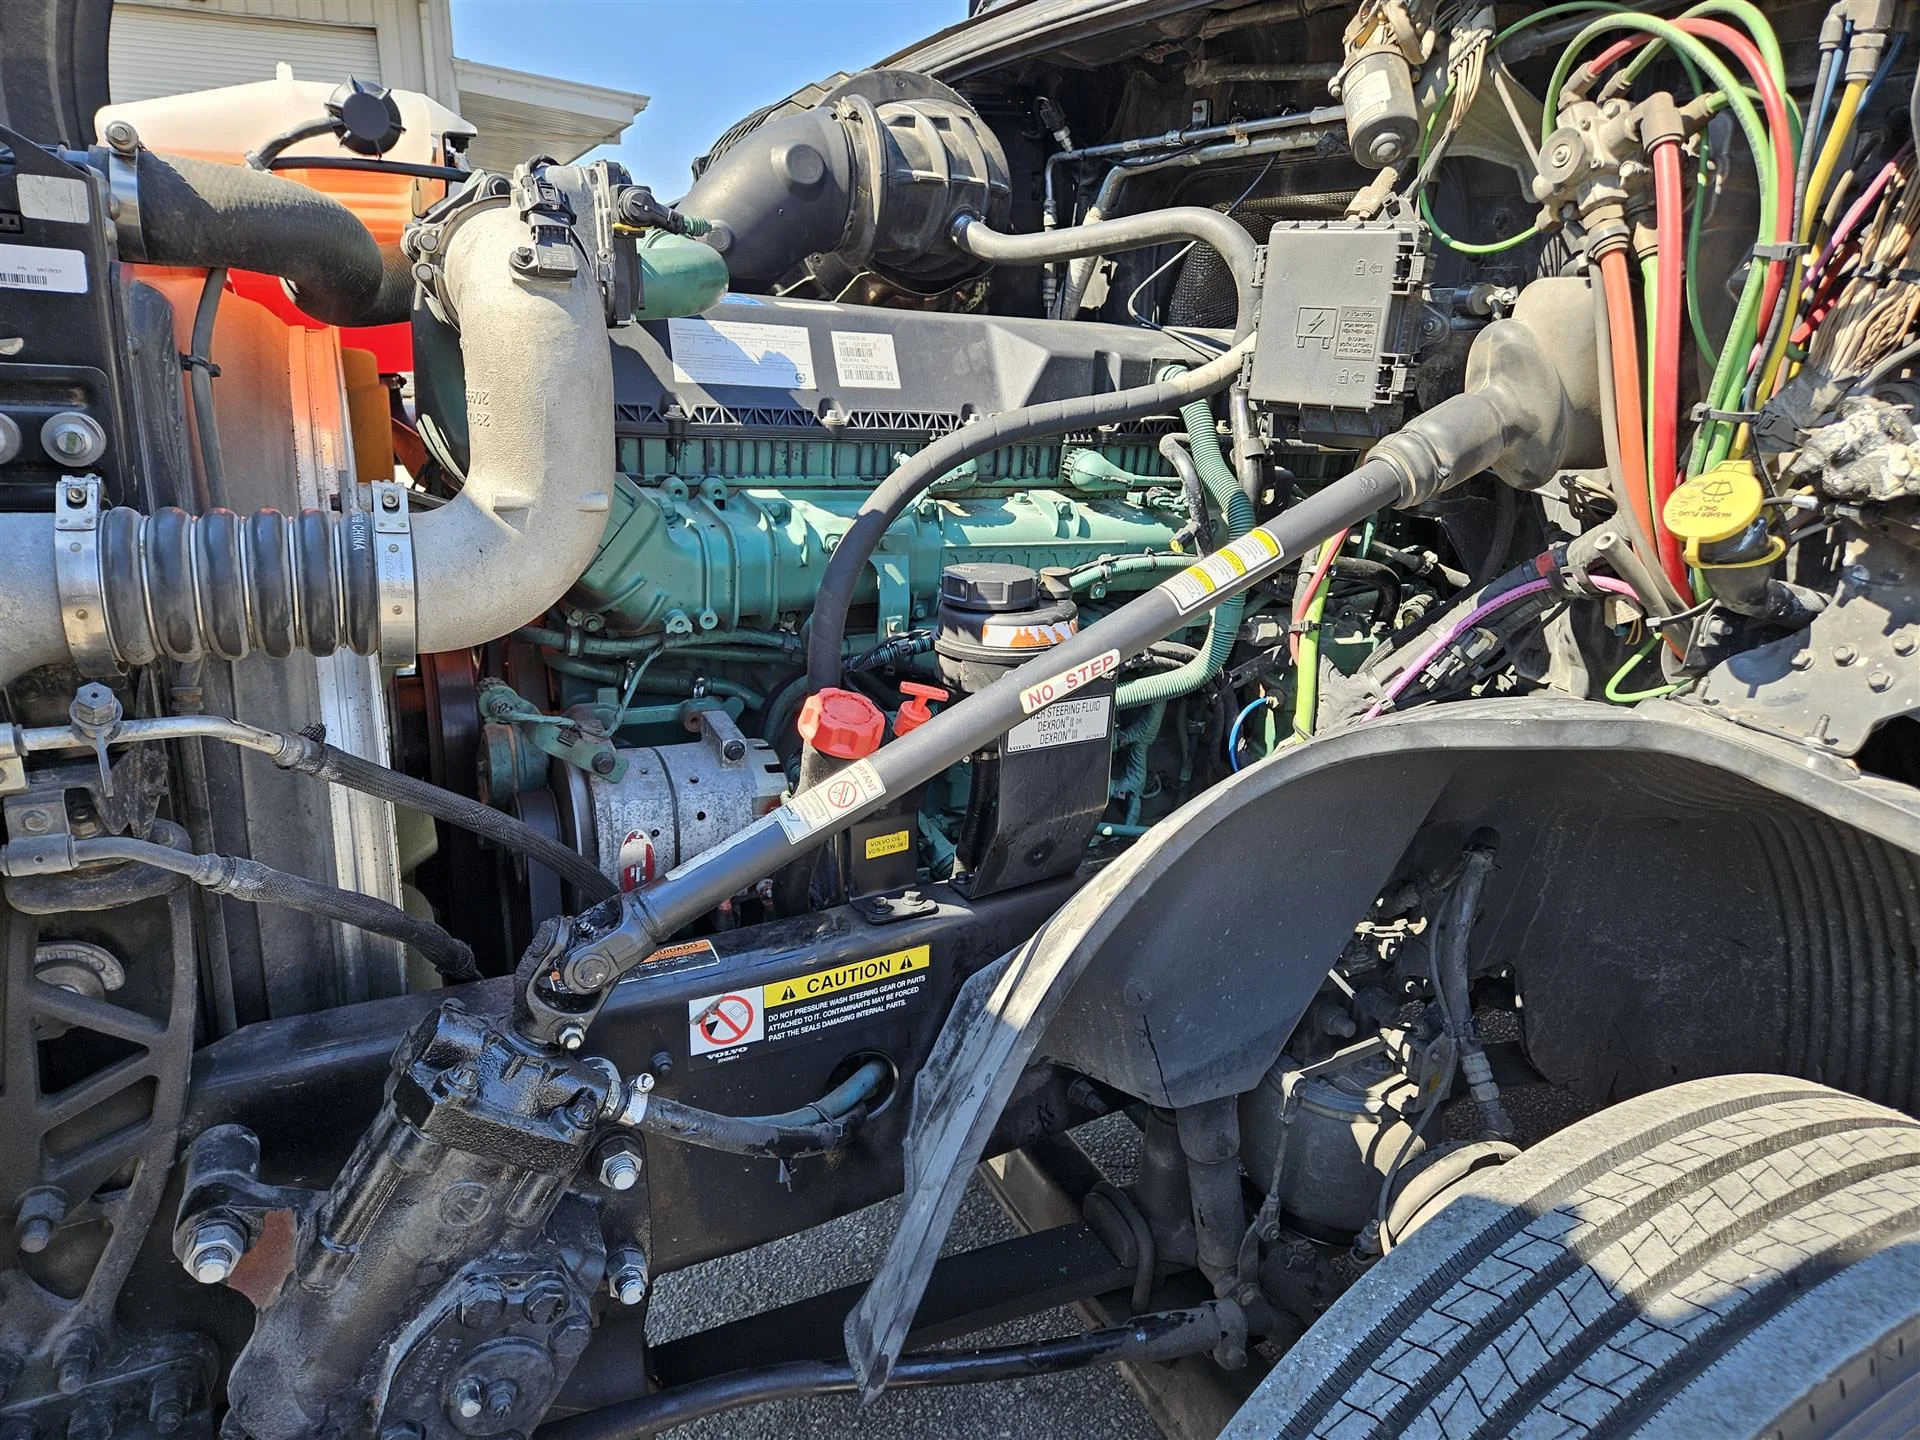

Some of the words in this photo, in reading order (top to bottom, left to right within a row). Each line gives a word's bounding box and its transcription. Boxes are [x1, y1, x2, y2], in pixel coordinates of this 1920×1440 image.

[352, 524, 366, 550] CHINA
[1028, 684, 1054, 709] NO
[1066, 655, 1114, 689] STEP
[1047, 703, 1080, 718] STEERING
[1081, 700, 1101, 713] FLUID
[1009, 743, 1031, 751] VOLVO
[870, 838, 891, 847] VOLVO
[807, 959, 891, 993] CAUTION
[768, 1014, 779, 1022] DO
[779, 1009, 793, 1020] NOT
[794, 1000, 829, 1016] PRESSURE
[828, 995, 848, 1007] WASH
[848, 987, 879, 1002] STEERING
[879, 982, 896, 993] GEAR
[896, 980, 907, 988] OR
[906, 974, 926, 986] PARTS
[768, 1017, 803, 1033] ATTACHED
[803, 1014, 813, 1023] TO
[813, 1012, 822, 1021] IT.
[822, 999, 871, 1018] CONTAMINANTS
[871, 995, 886, 1005] MAY
[885, 992, 895, 1001] BE
[894, 986, 920, 999] FORCED
[768, 1031, 786, 1043] PAST
[786, 1027, 800, 1038] THE
[800, 1022, 821, 1034] SEALS
[821, 1013, 855, 1029] DAMAGING
[855, 1005, 886, 1019] INTERNAL
[885, 998, 907, 1011] PARTS.
[706, 1046, 749, 1060] VOLVO
